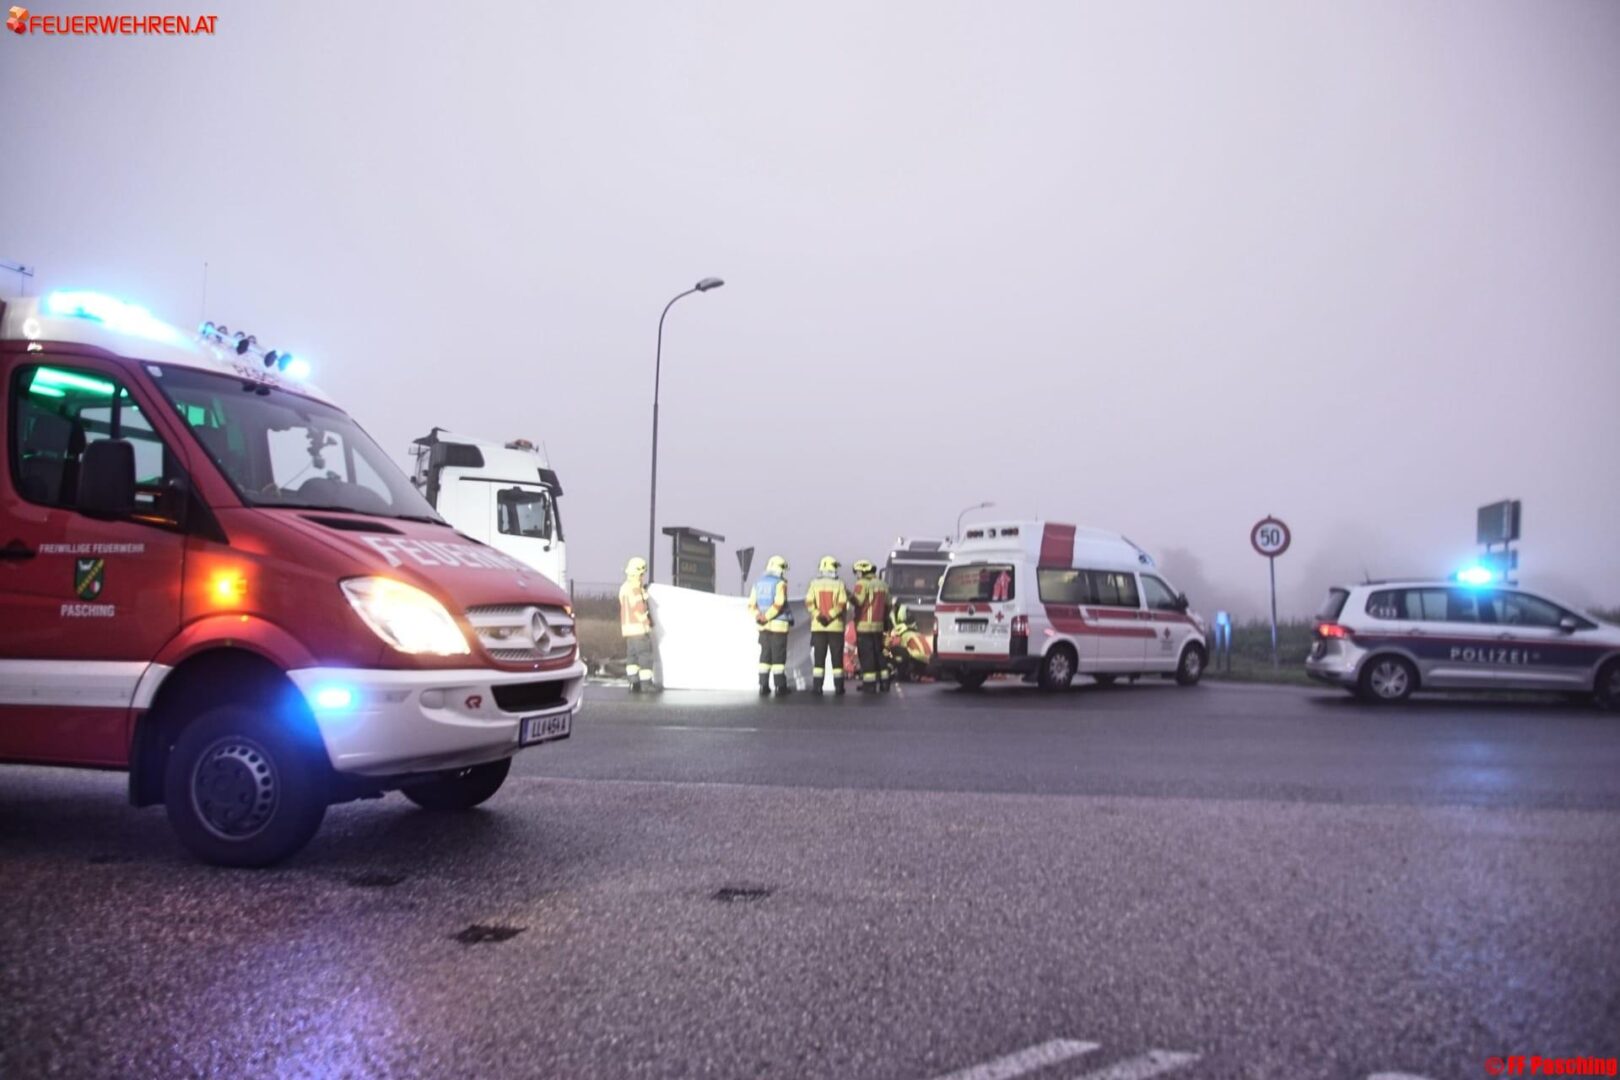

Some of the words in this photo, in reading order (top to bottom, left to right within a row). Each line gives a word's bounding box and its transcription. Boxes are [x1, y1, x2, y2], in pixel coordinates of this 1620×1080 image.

[1260, 528, 1280, 546] 50
[39, 543, 91, 554] FREIWILLIGE
[92, 543, 145, 554] FEUERWEHR
[61, 605, 115, 617] PASCHING
[1450, 646, 1528, 664] POLIZEI
